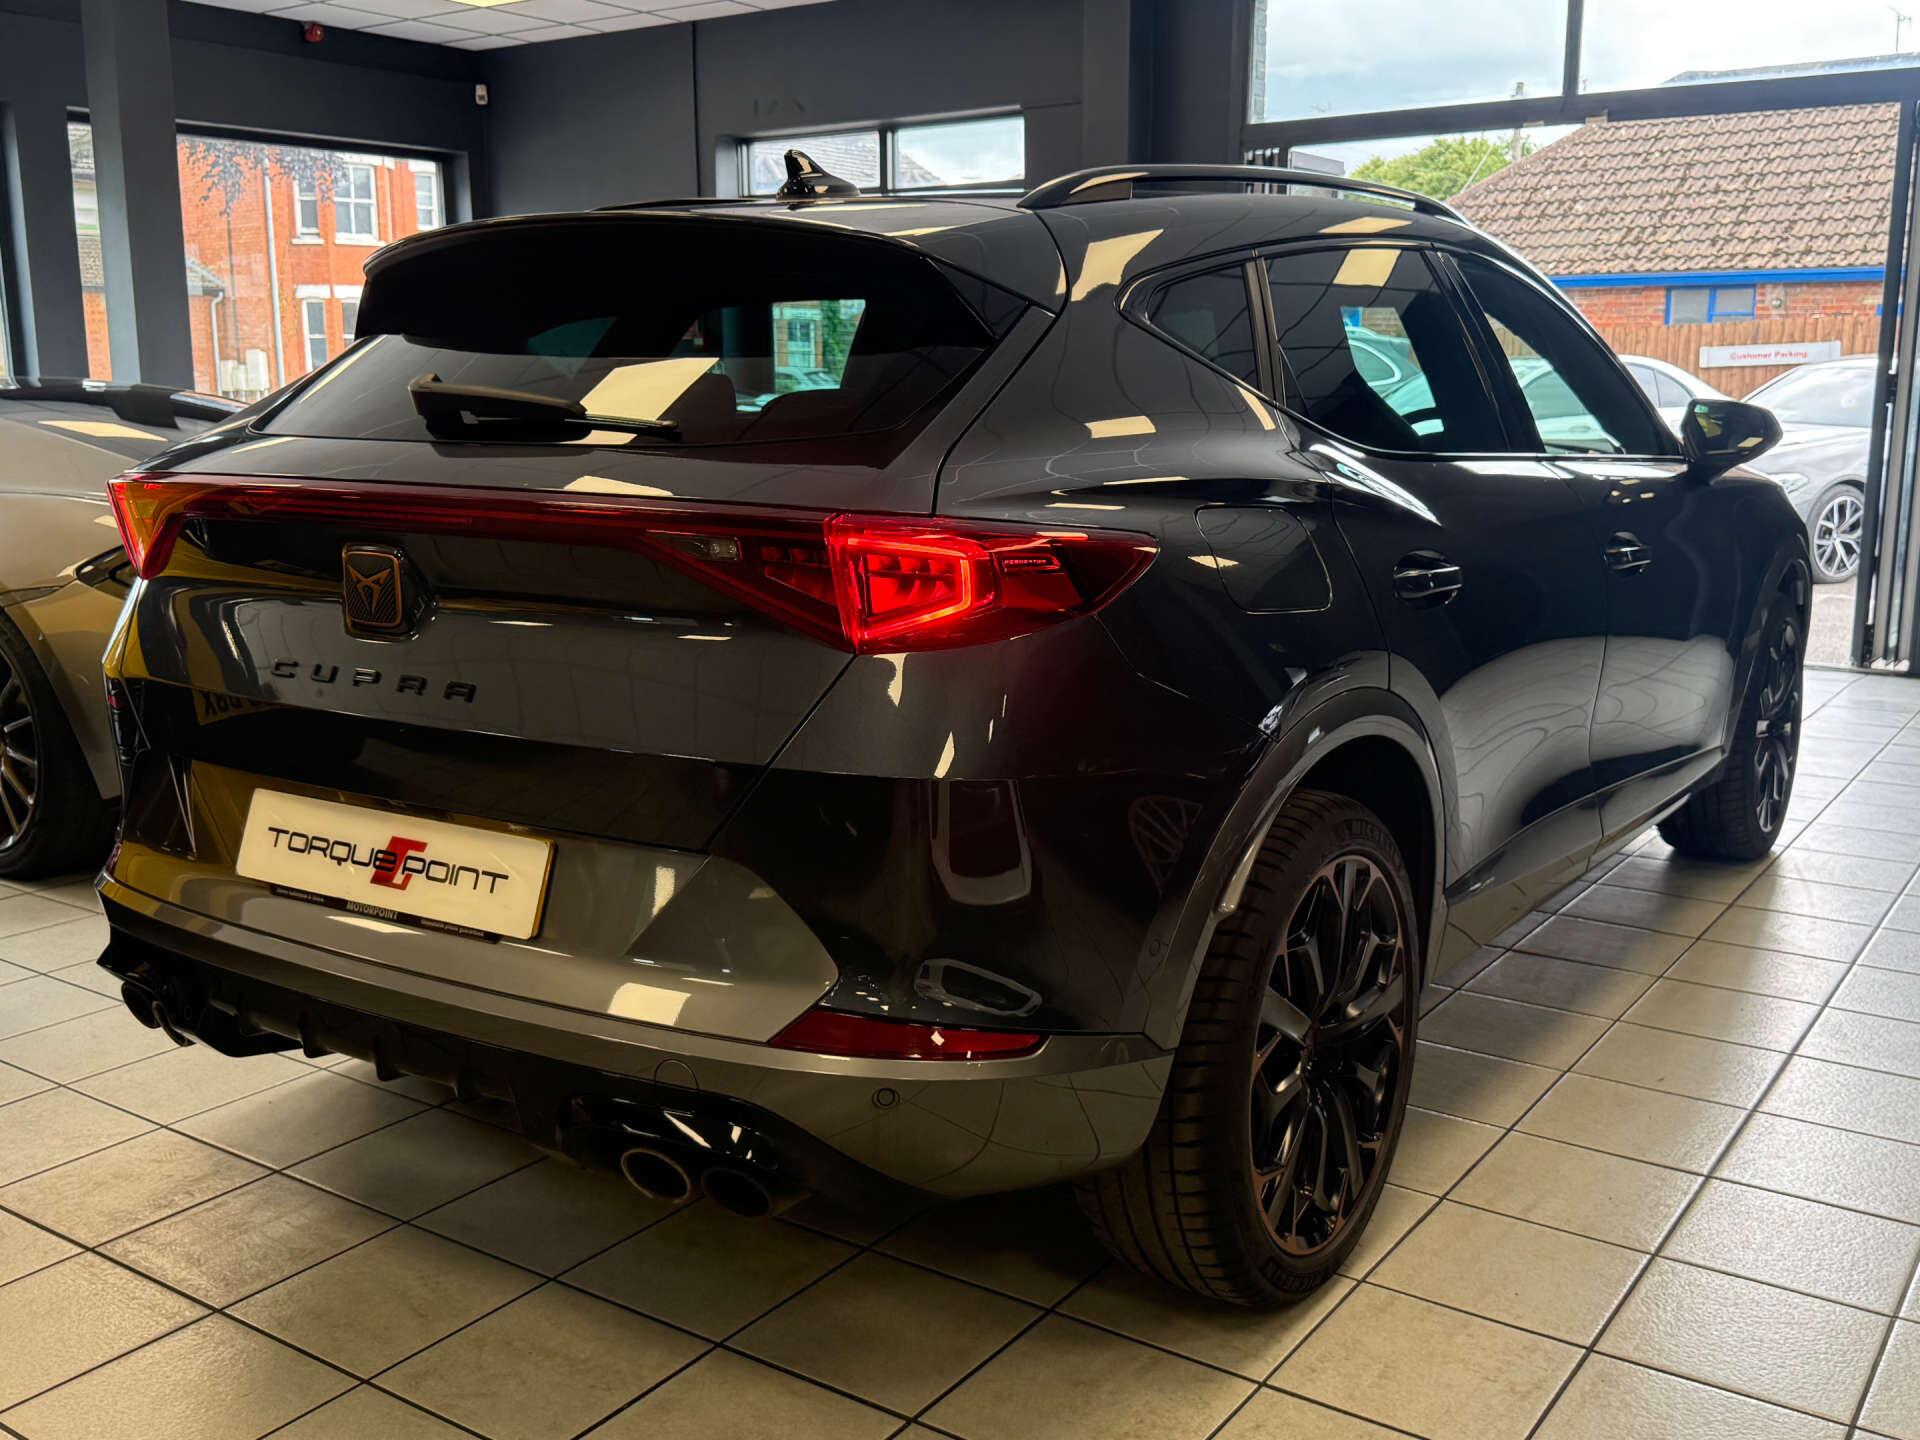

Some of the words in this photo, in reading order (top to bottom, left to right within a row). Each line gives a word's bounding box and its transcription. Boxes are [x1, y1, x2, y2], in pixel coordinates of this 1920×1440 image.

[1729, 351, 1772, 361] Customer
[1774, 350, 1809, 360] Parking
[271, 660, 478, 703] CUPRA
[345, 901, 399, 921] MOTORPOINT
